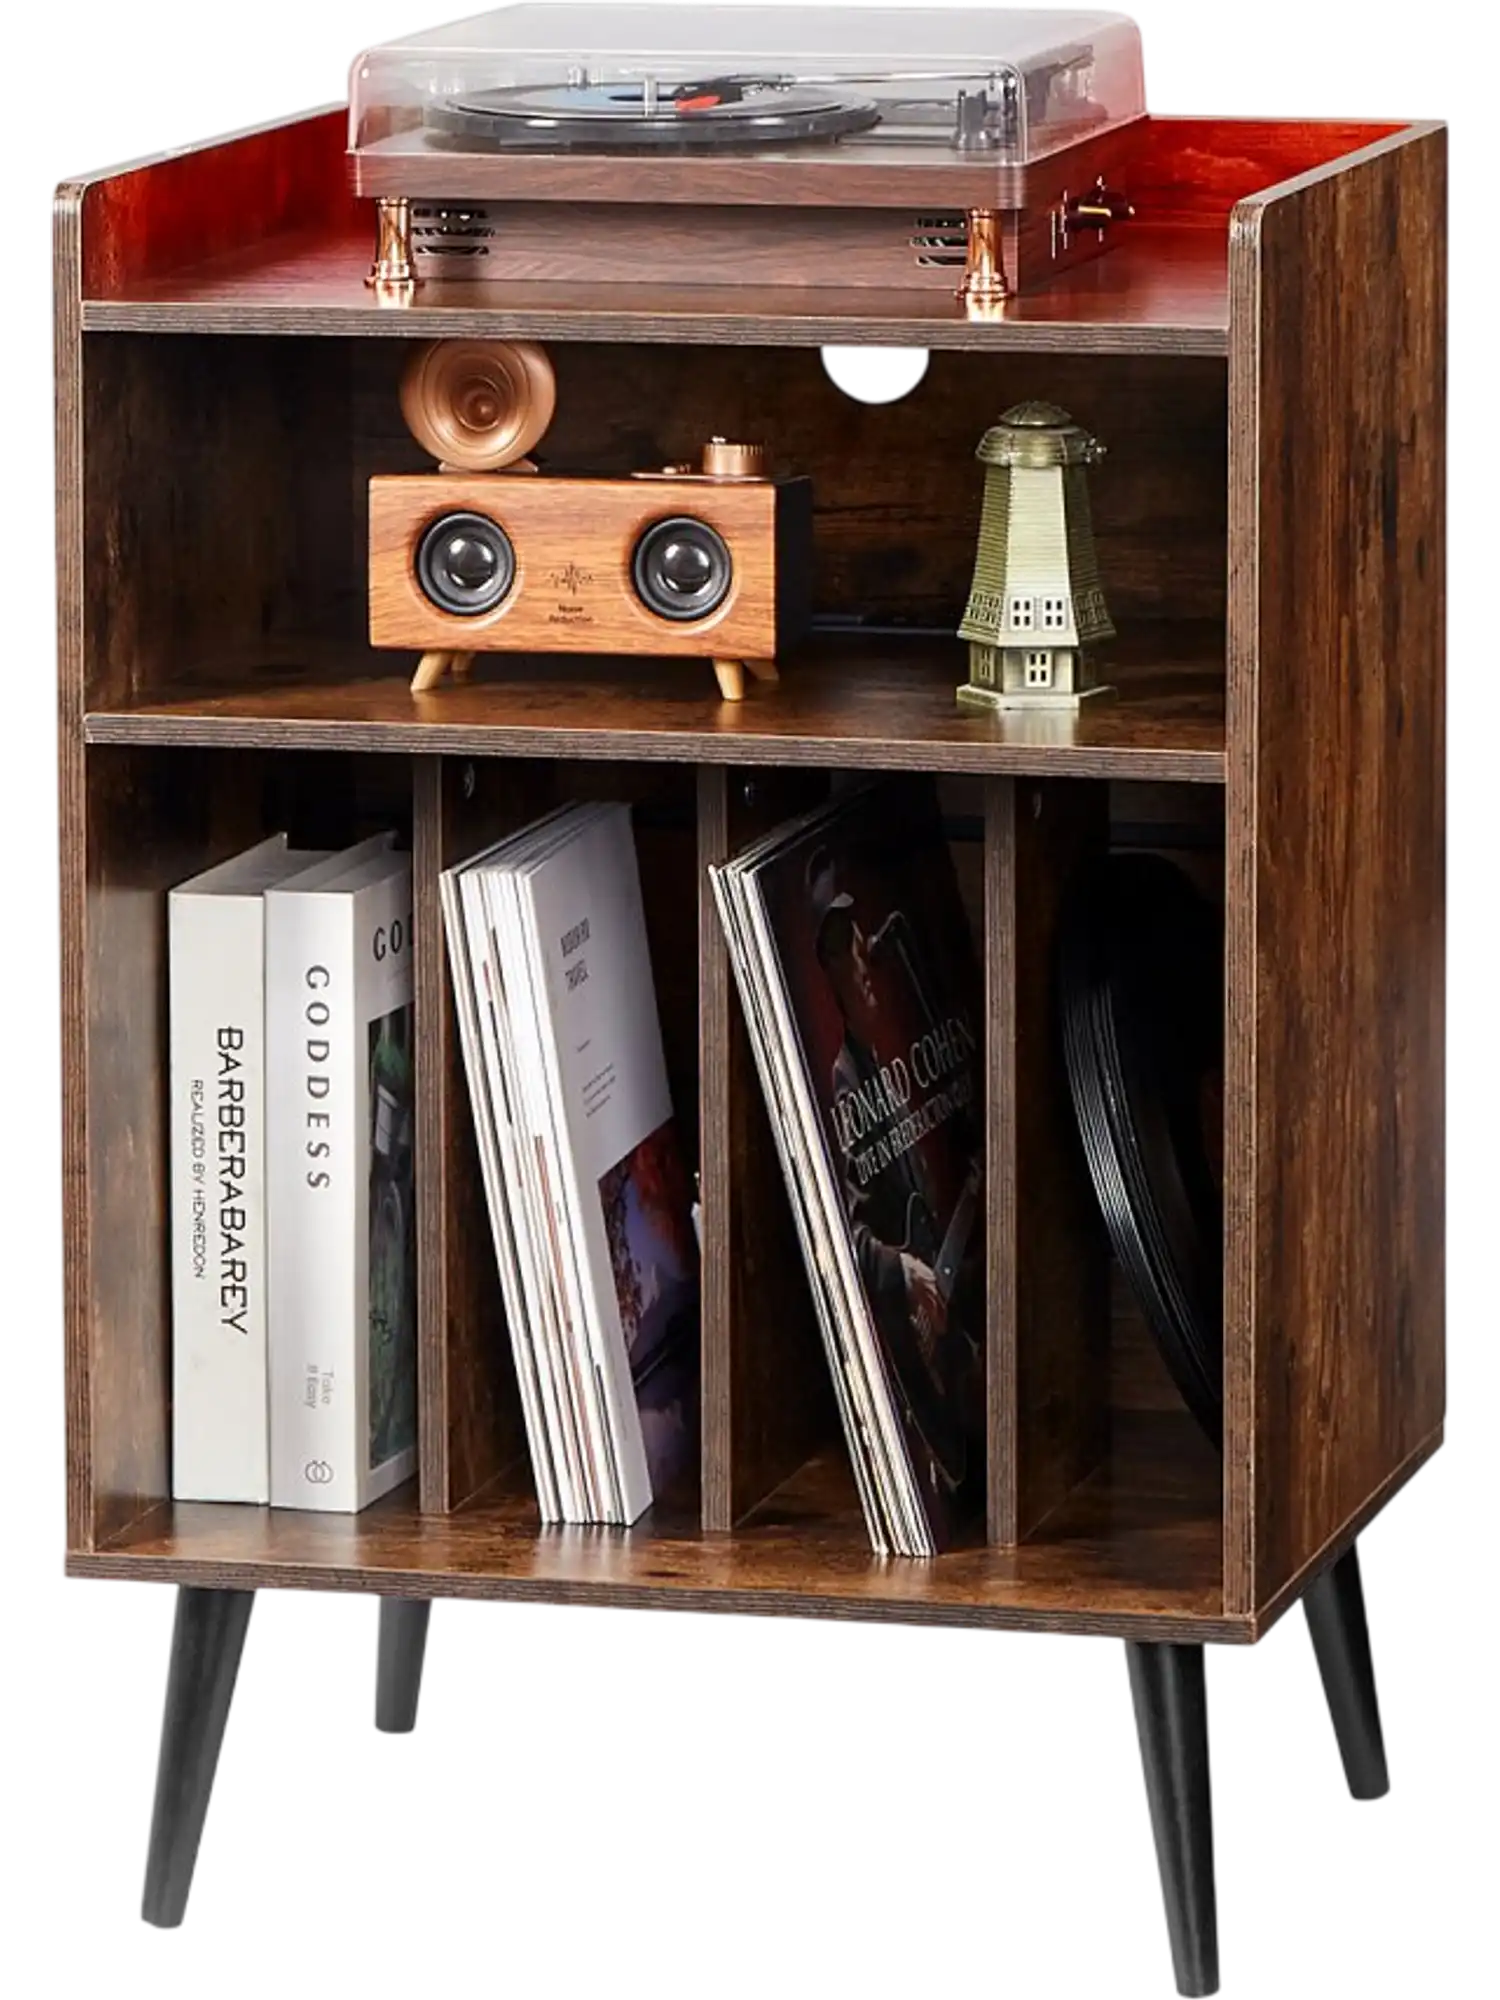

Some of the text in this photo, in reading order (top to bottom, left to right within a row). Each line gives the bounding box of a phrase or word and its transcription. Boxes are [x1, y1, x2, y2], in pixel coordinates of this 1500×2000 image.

[373, 912, 413, 962] GO
[305, 964, 331, 1190] GODDESS
[829, 1056, 911, 1153] LEONARD
[910, 1014, 977, 1088] COHEN
[191, 1079, 207, 1280] REALIZED BY HENREDON
[216, 1025, 249, 1336] BARBERABAREY
